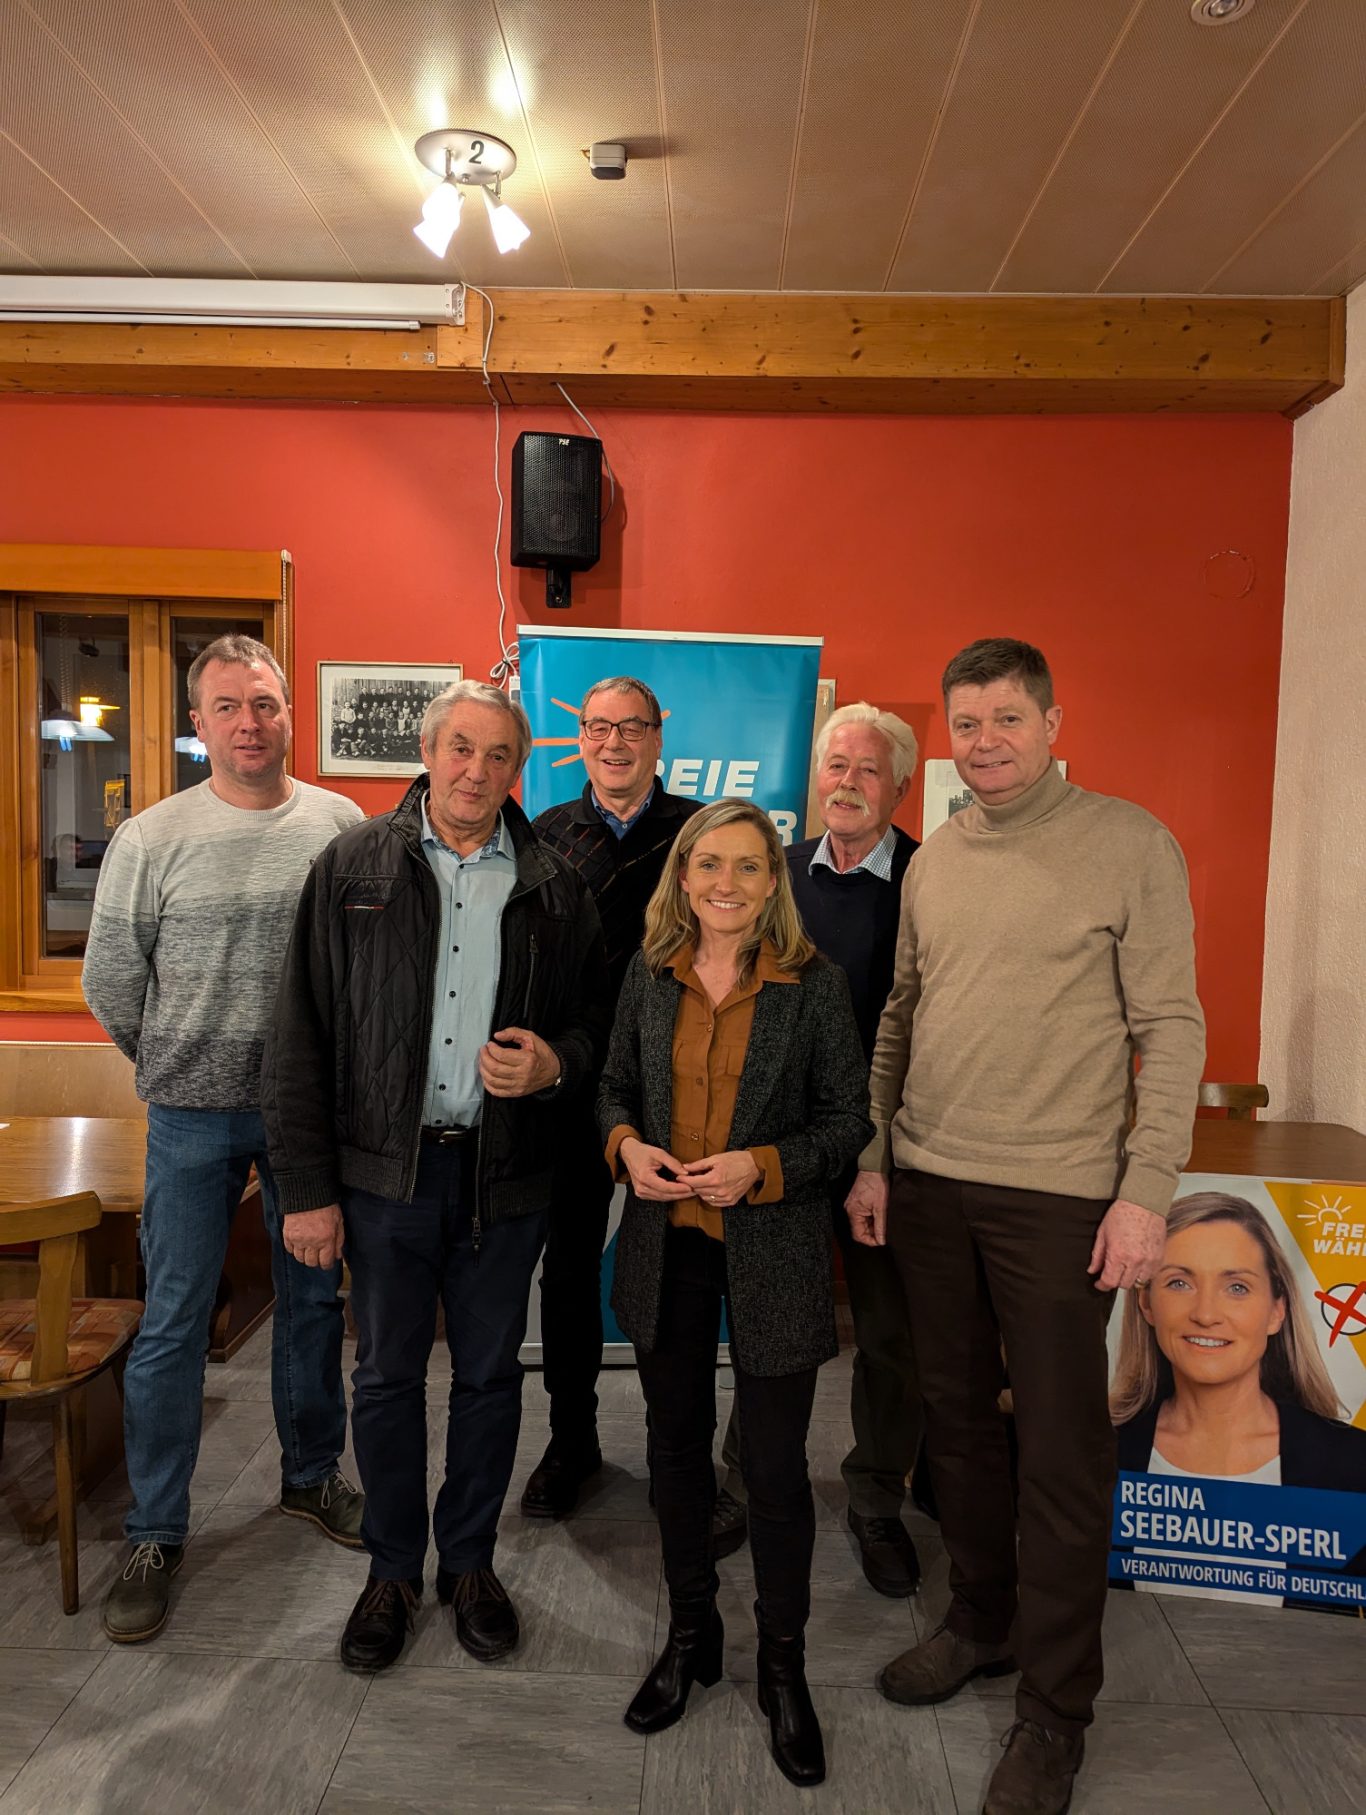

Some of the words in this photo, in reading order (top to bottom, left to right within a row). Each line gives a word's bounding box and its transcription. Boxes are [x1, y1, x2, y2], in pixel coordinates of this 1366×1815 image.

[469, 140, 485, 165] 2
[655, 759, 760, 797] EIE
[1321, 1221, 1366, 1238] FRE
[1121, 1480, 1206, 1511] REGINA
[1120, 1510, 1347, 1561] SEEBAUER-SPERL
[1121, 1558, 1254, 1587] VERANTWORTUNG
[1258, 1569, 1287, 1591] FÜR
[1291, 1576, 1366, 1600] DEUTSCHL
